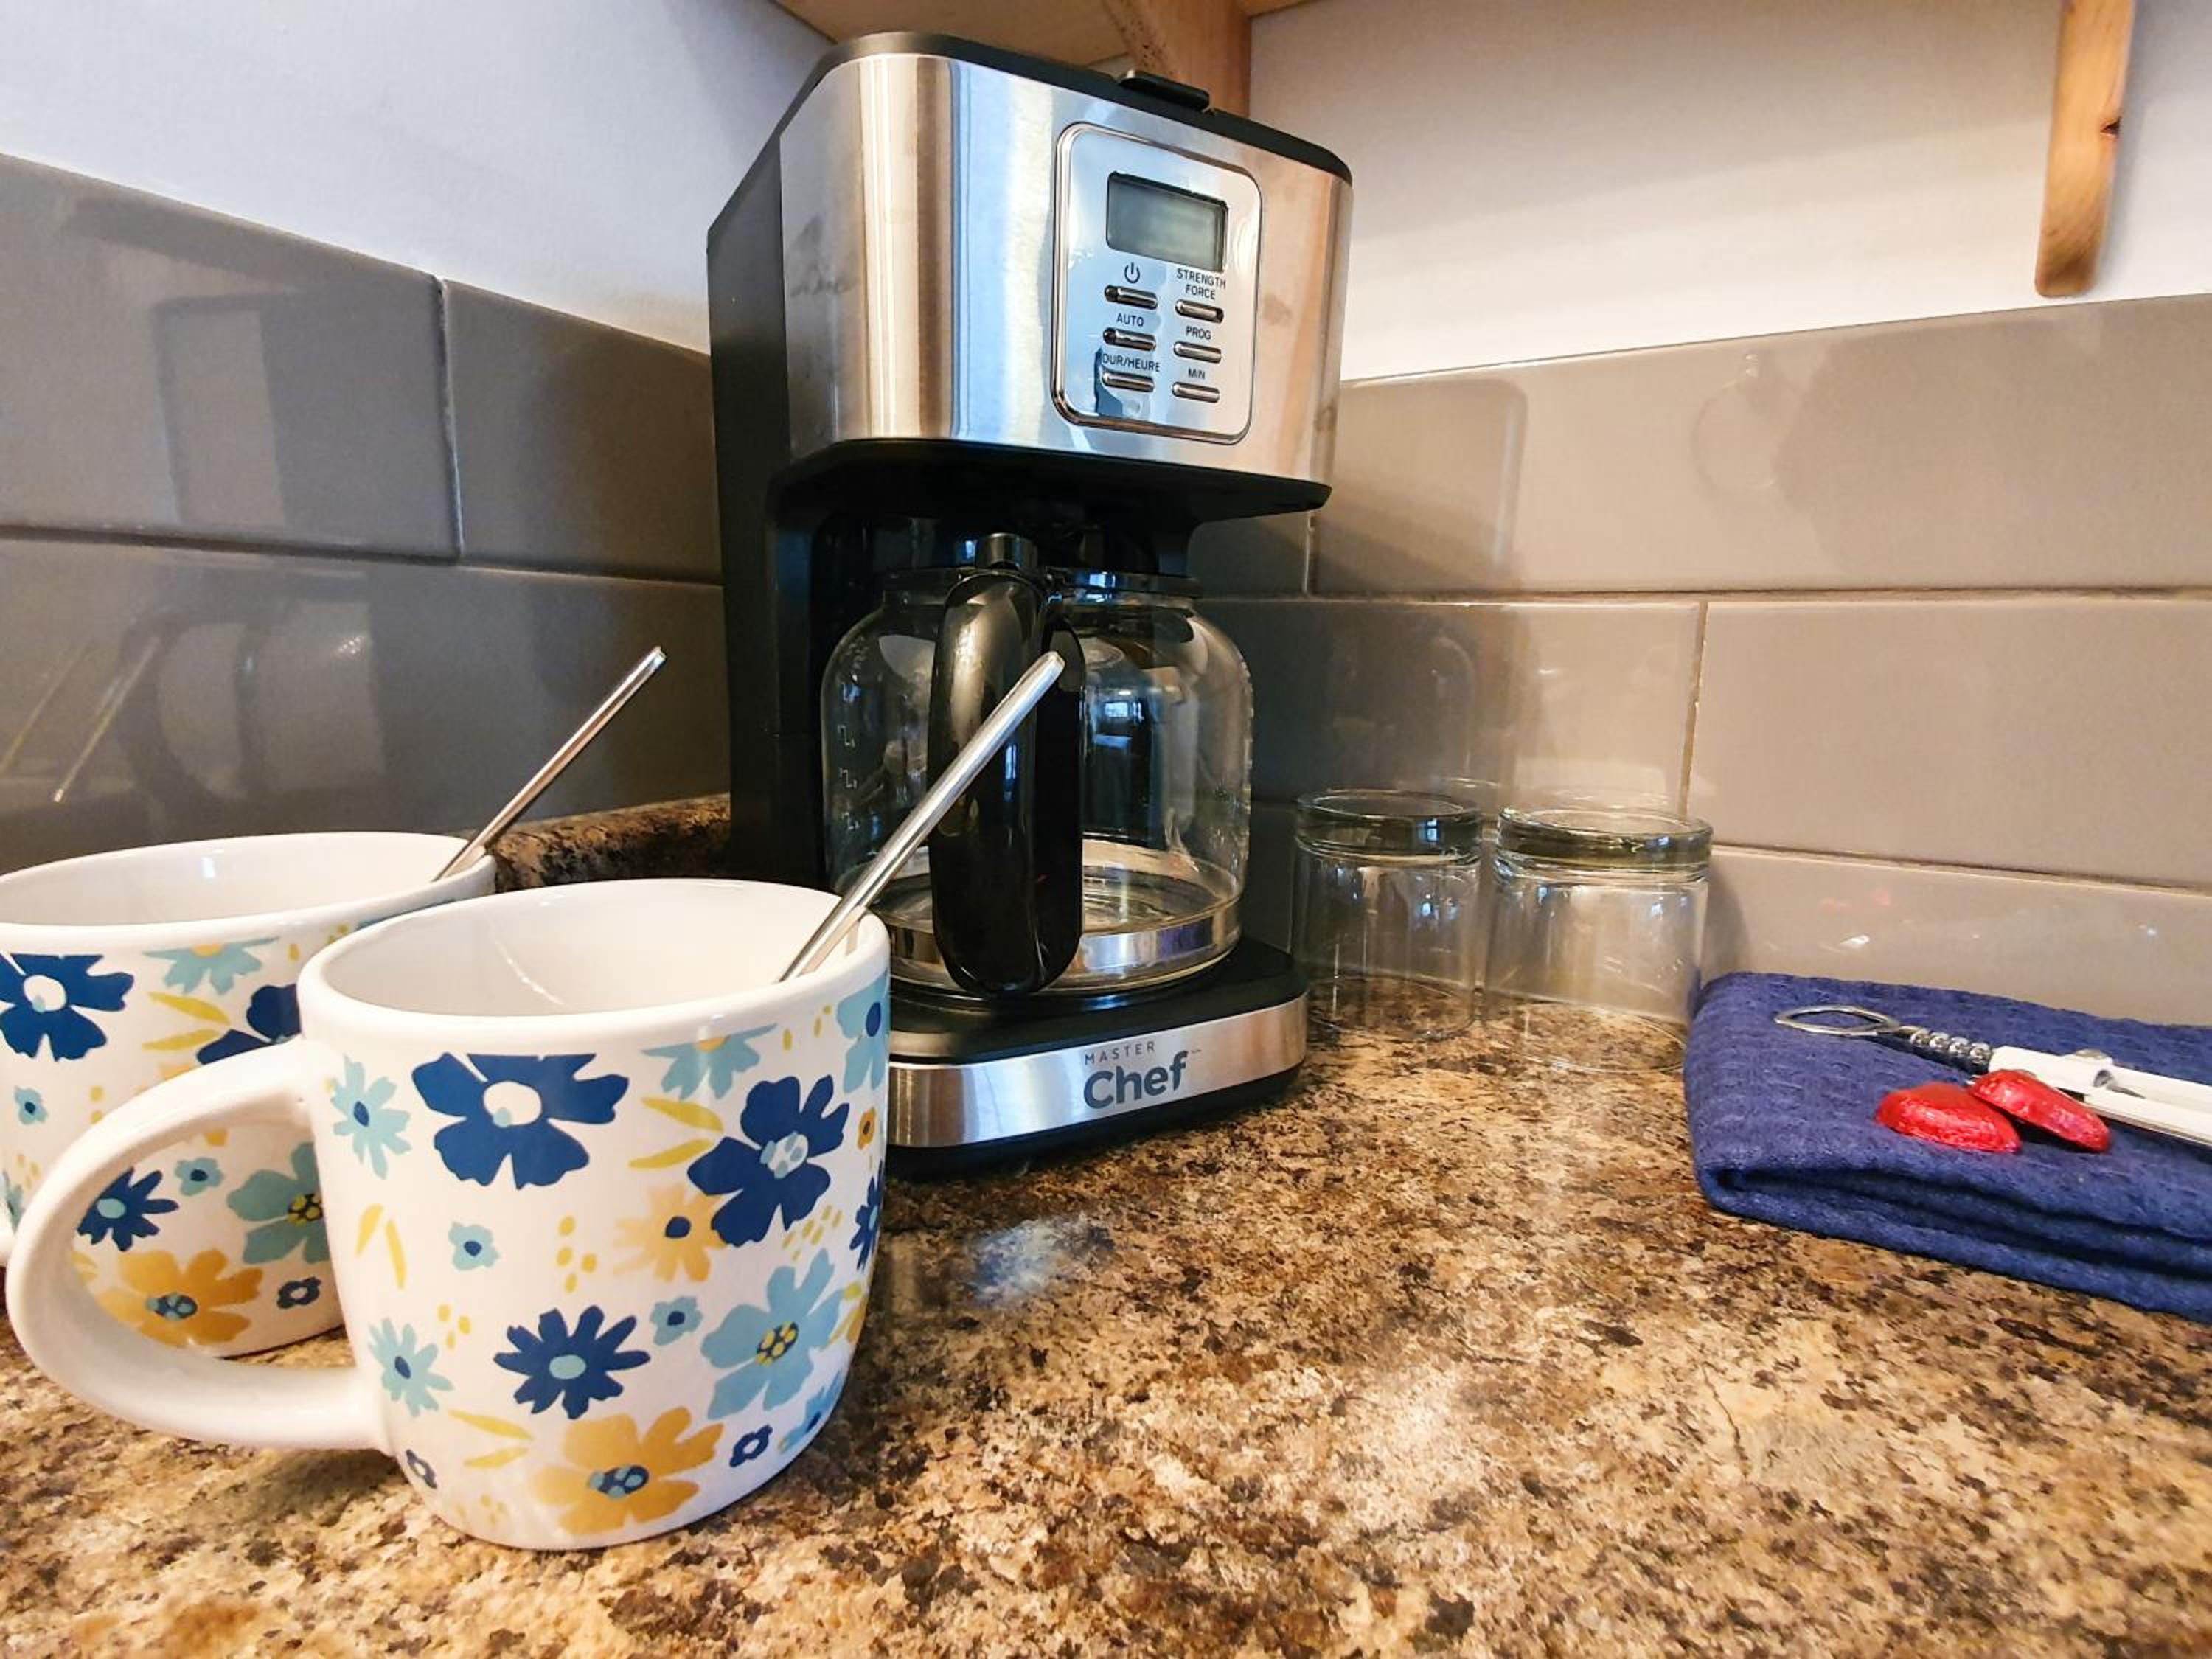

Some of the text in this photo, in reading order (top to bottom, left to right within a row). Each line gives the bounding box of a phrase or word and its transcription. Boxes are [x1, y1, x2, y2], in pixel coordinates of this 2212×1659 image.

[1177, 268, 1226, 289] STRENGTH
[1185, 285, 1216, 300] FORCE
[1116, 313, 1144, 327] AUTO
[1186, 326, 1211, 340] PROG
[1188, 368, 1206, 380] MIN
[1085, 1041, 1155, 1065] MASTER
[1084, 1051, 1188, 1109] Chef
